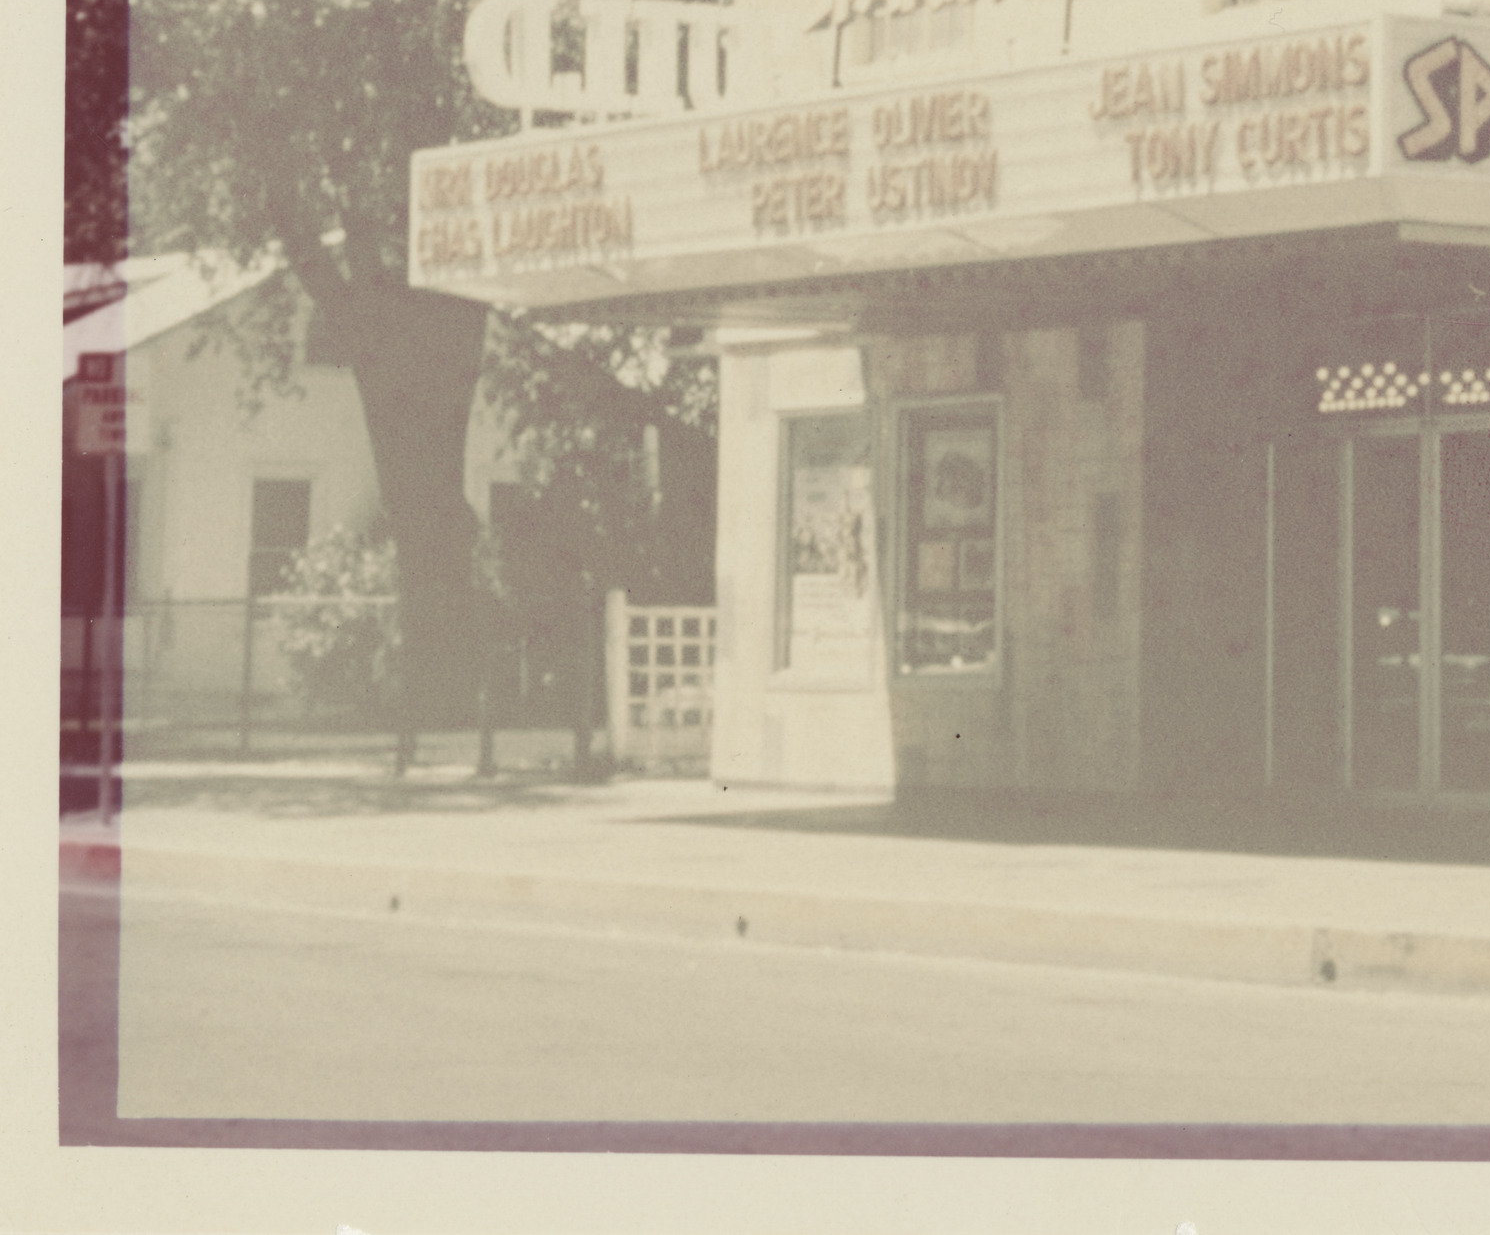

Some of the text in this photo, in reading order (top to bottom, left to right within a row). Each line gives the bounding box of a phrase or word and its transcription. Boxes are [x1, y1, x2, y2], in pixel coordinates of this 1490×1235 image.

[1088, 34, 1370, 121] JEAN SIMMONS
[484, 144, 603, 200] DOUGLAS
[698, 90, 992, 174] LAURENCE OLIVIER
[1123, 106, 1370, 185] TONY CURTIS
[493, 195, 634, 257] LAUGHTON
[751, 149, 999, 230] PETER USTINOV
